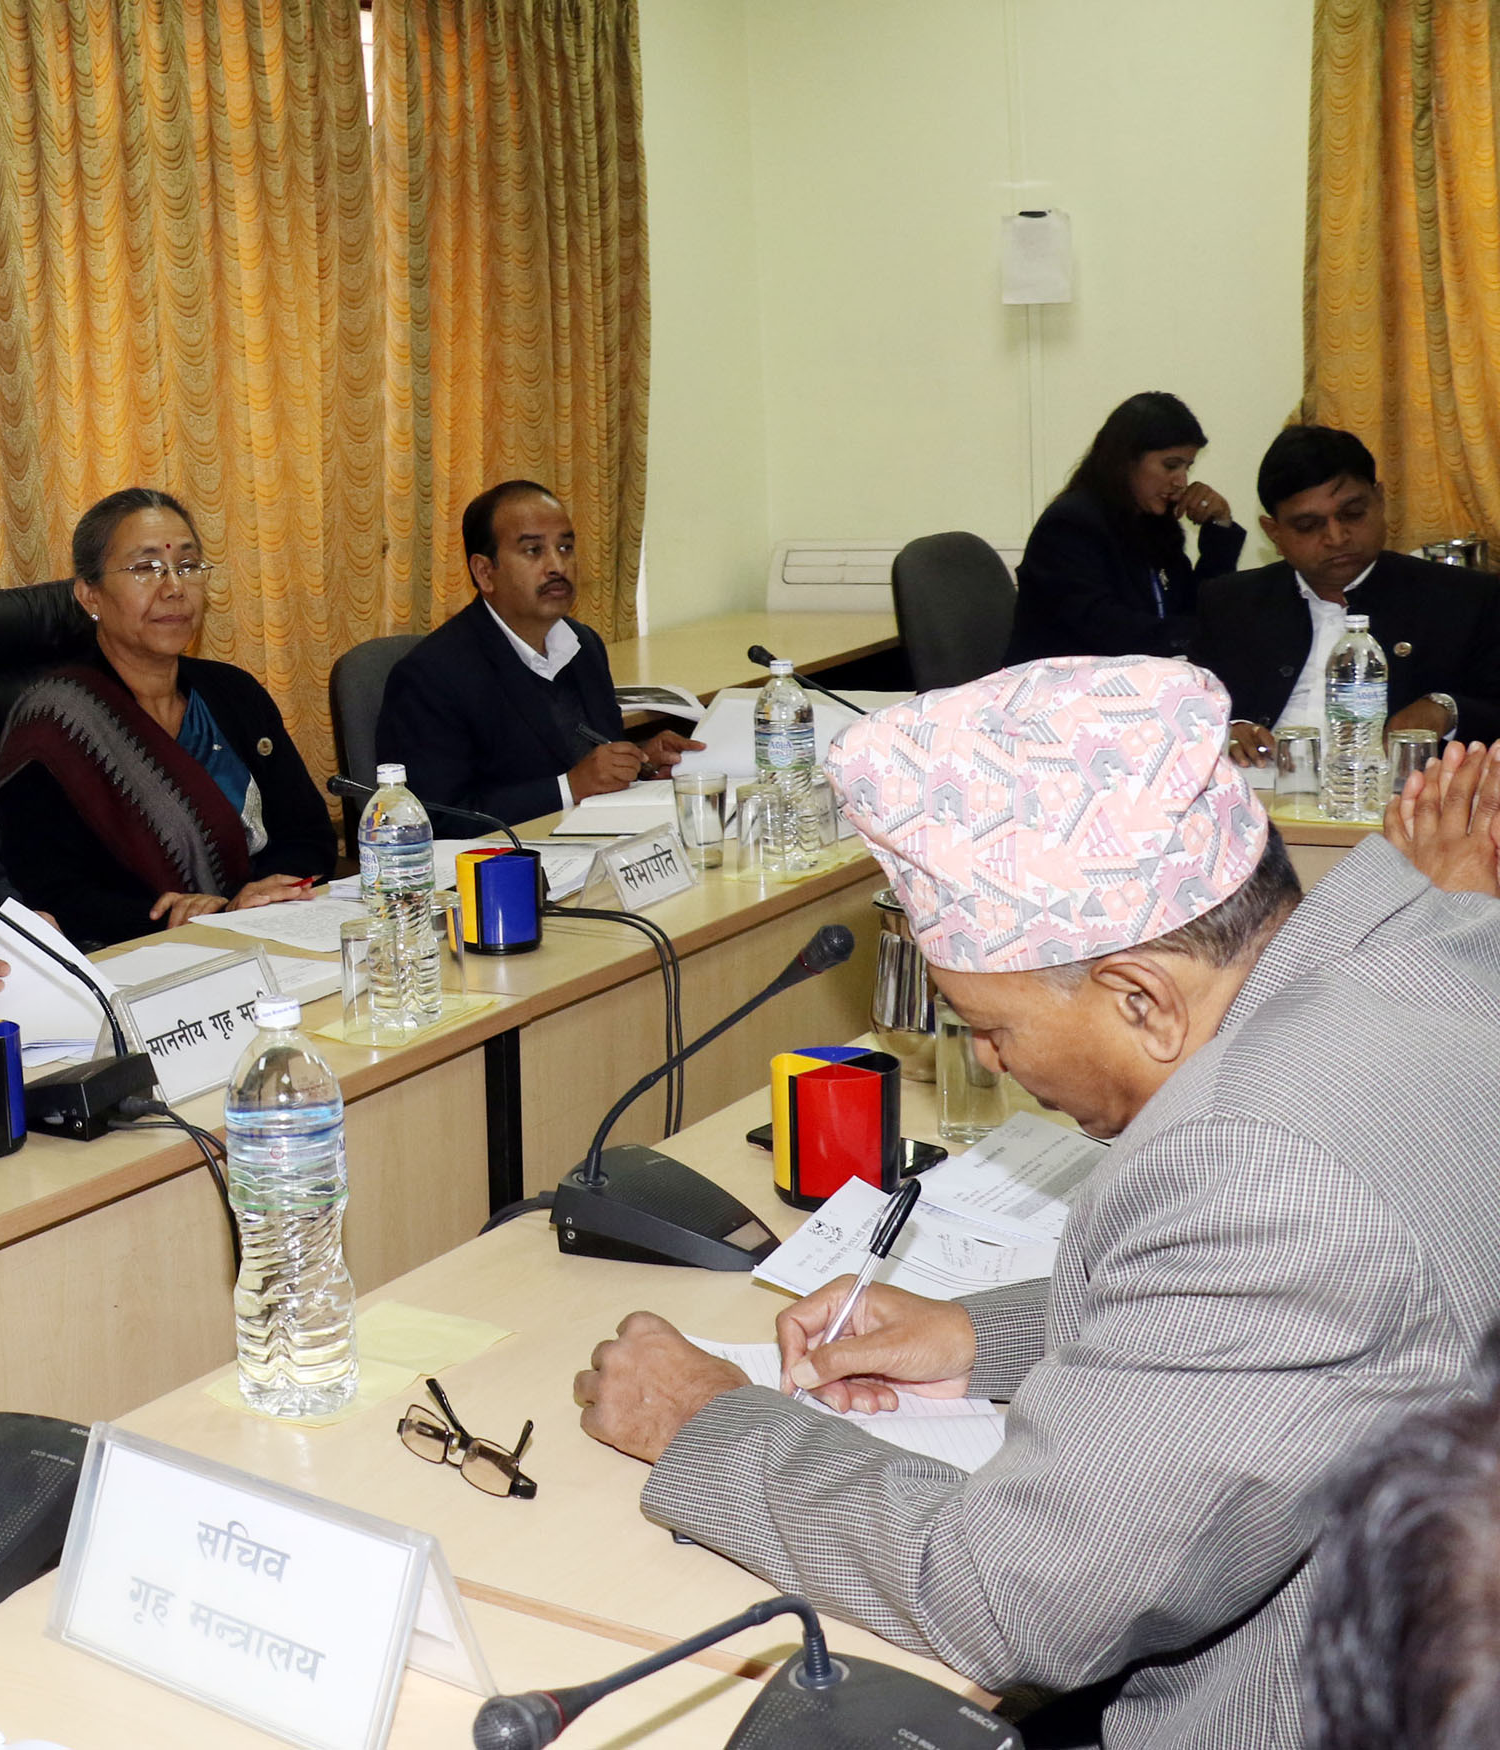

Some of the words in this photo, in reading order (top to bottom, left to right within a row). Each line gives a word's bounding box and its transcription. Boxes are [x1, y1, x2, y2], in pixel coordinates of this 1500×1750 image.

[619, 843, 679, 891] सभापति
[146, 1019, 208, 1057] माननीय
[208, 1009, 234, 1040] गृह
[196, 1520, 291, 1583] सचिव
[129, 1576, 176, 1629] गृह
[190, 1600, 326, 1683] मन्त्रालय
[957, 1706, 1000, 1732] BOSCH
